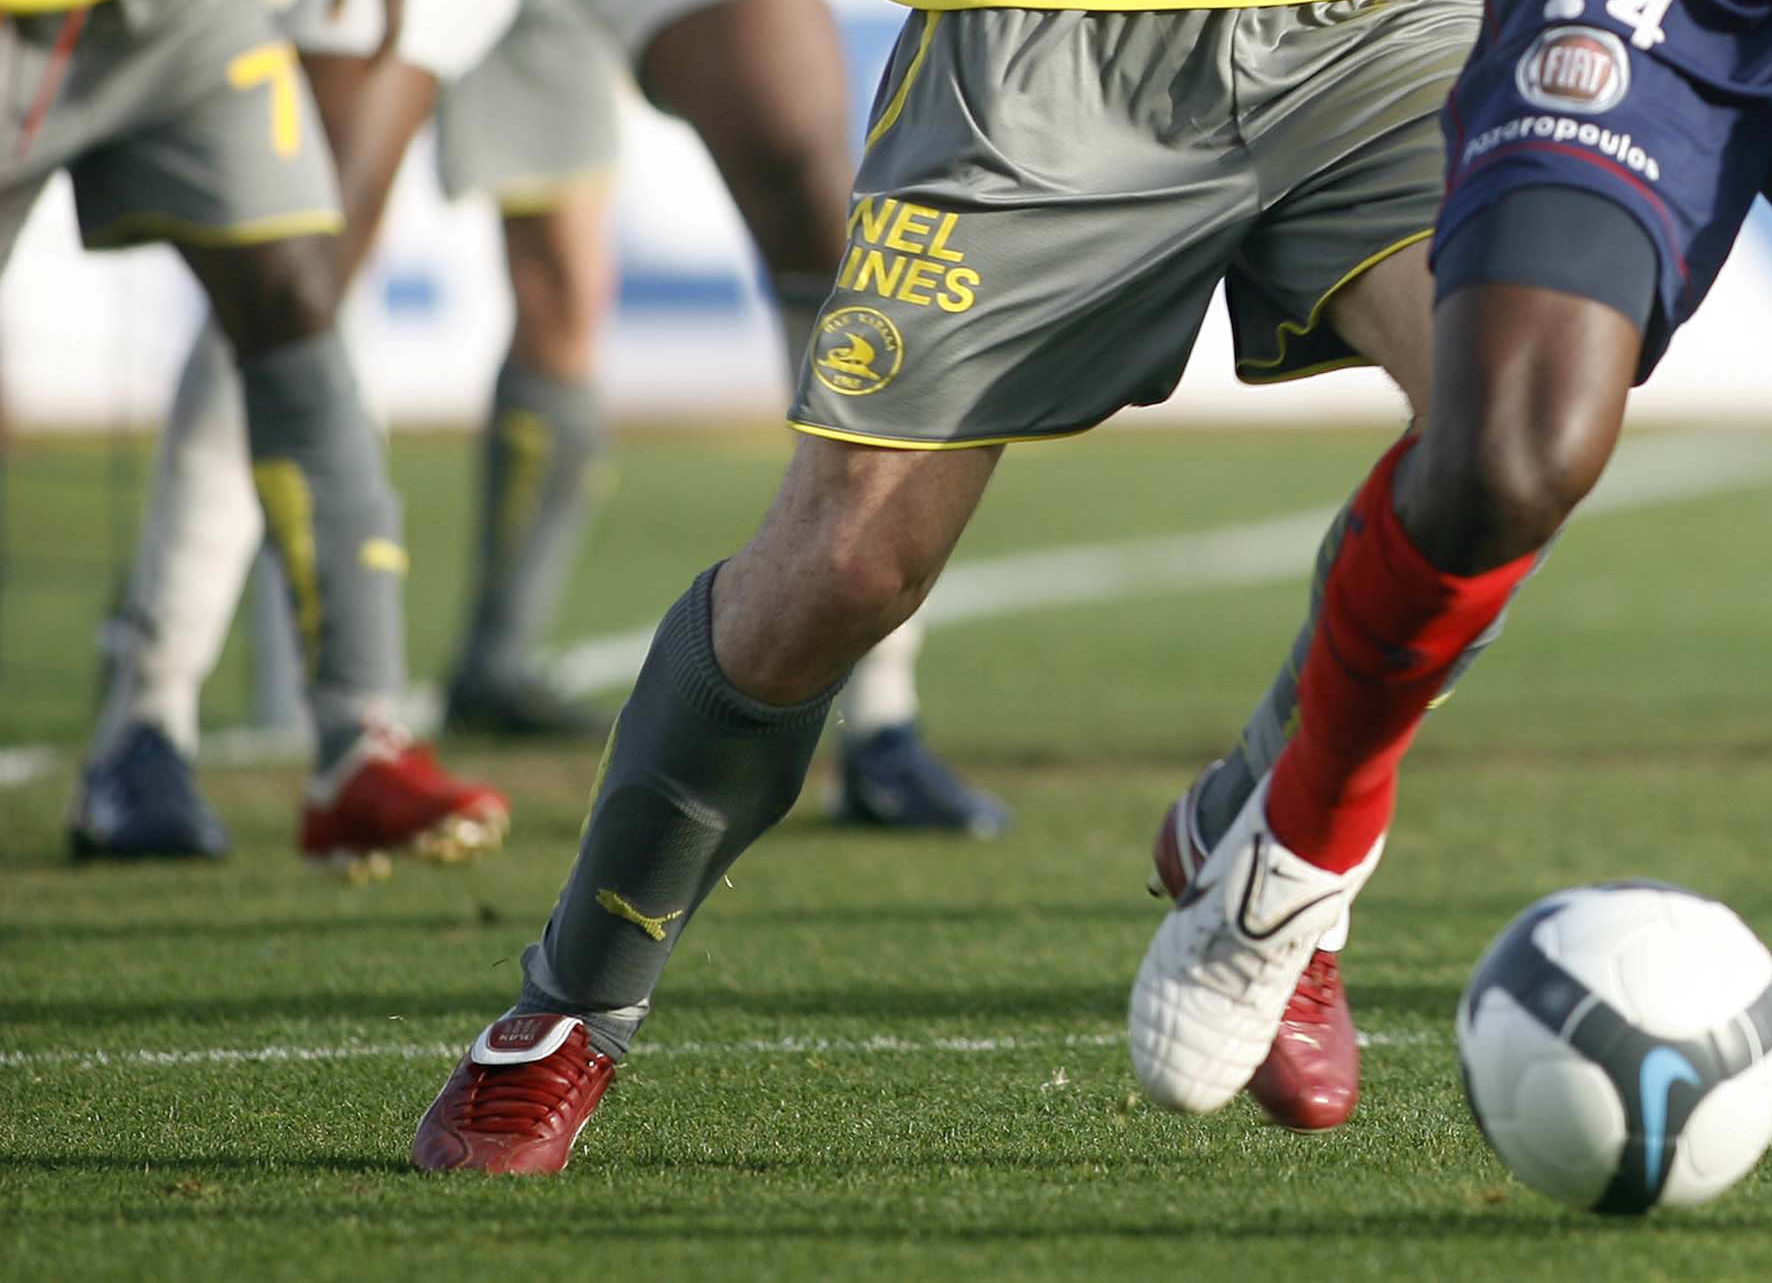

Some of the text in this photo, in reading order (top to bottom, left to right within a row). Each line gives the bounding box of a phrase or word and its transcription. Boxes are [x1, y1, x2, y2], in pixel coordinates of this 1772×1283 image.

[225, 43, 300, 159] 7
[1541, 45, 1612, 93] FIAT
[847, 196, 964, 263] NEL
[838, 246, 980, 314] INES
